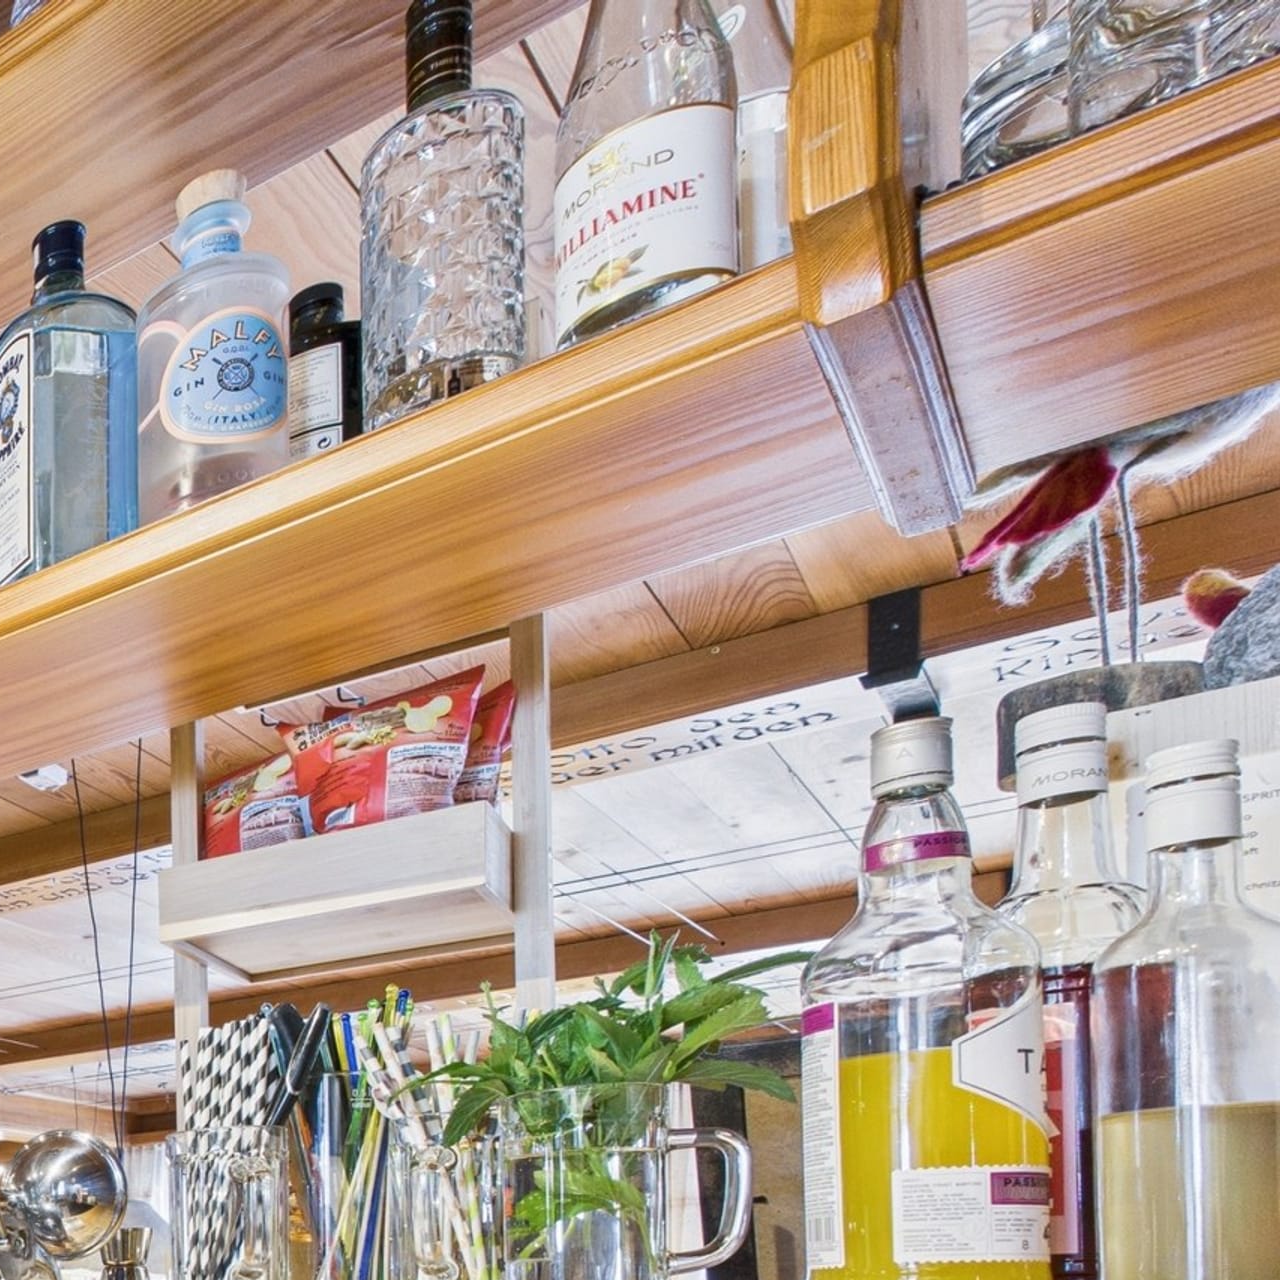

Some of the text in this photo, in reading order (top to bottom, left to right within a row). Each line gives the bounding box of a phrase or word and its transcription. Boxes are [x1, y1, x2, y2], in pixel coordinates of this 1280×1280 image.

[179, 320, 282, 372] MALFY
[173, 378, 205, 397] GIN
[651, 733, 723, 763] mit
